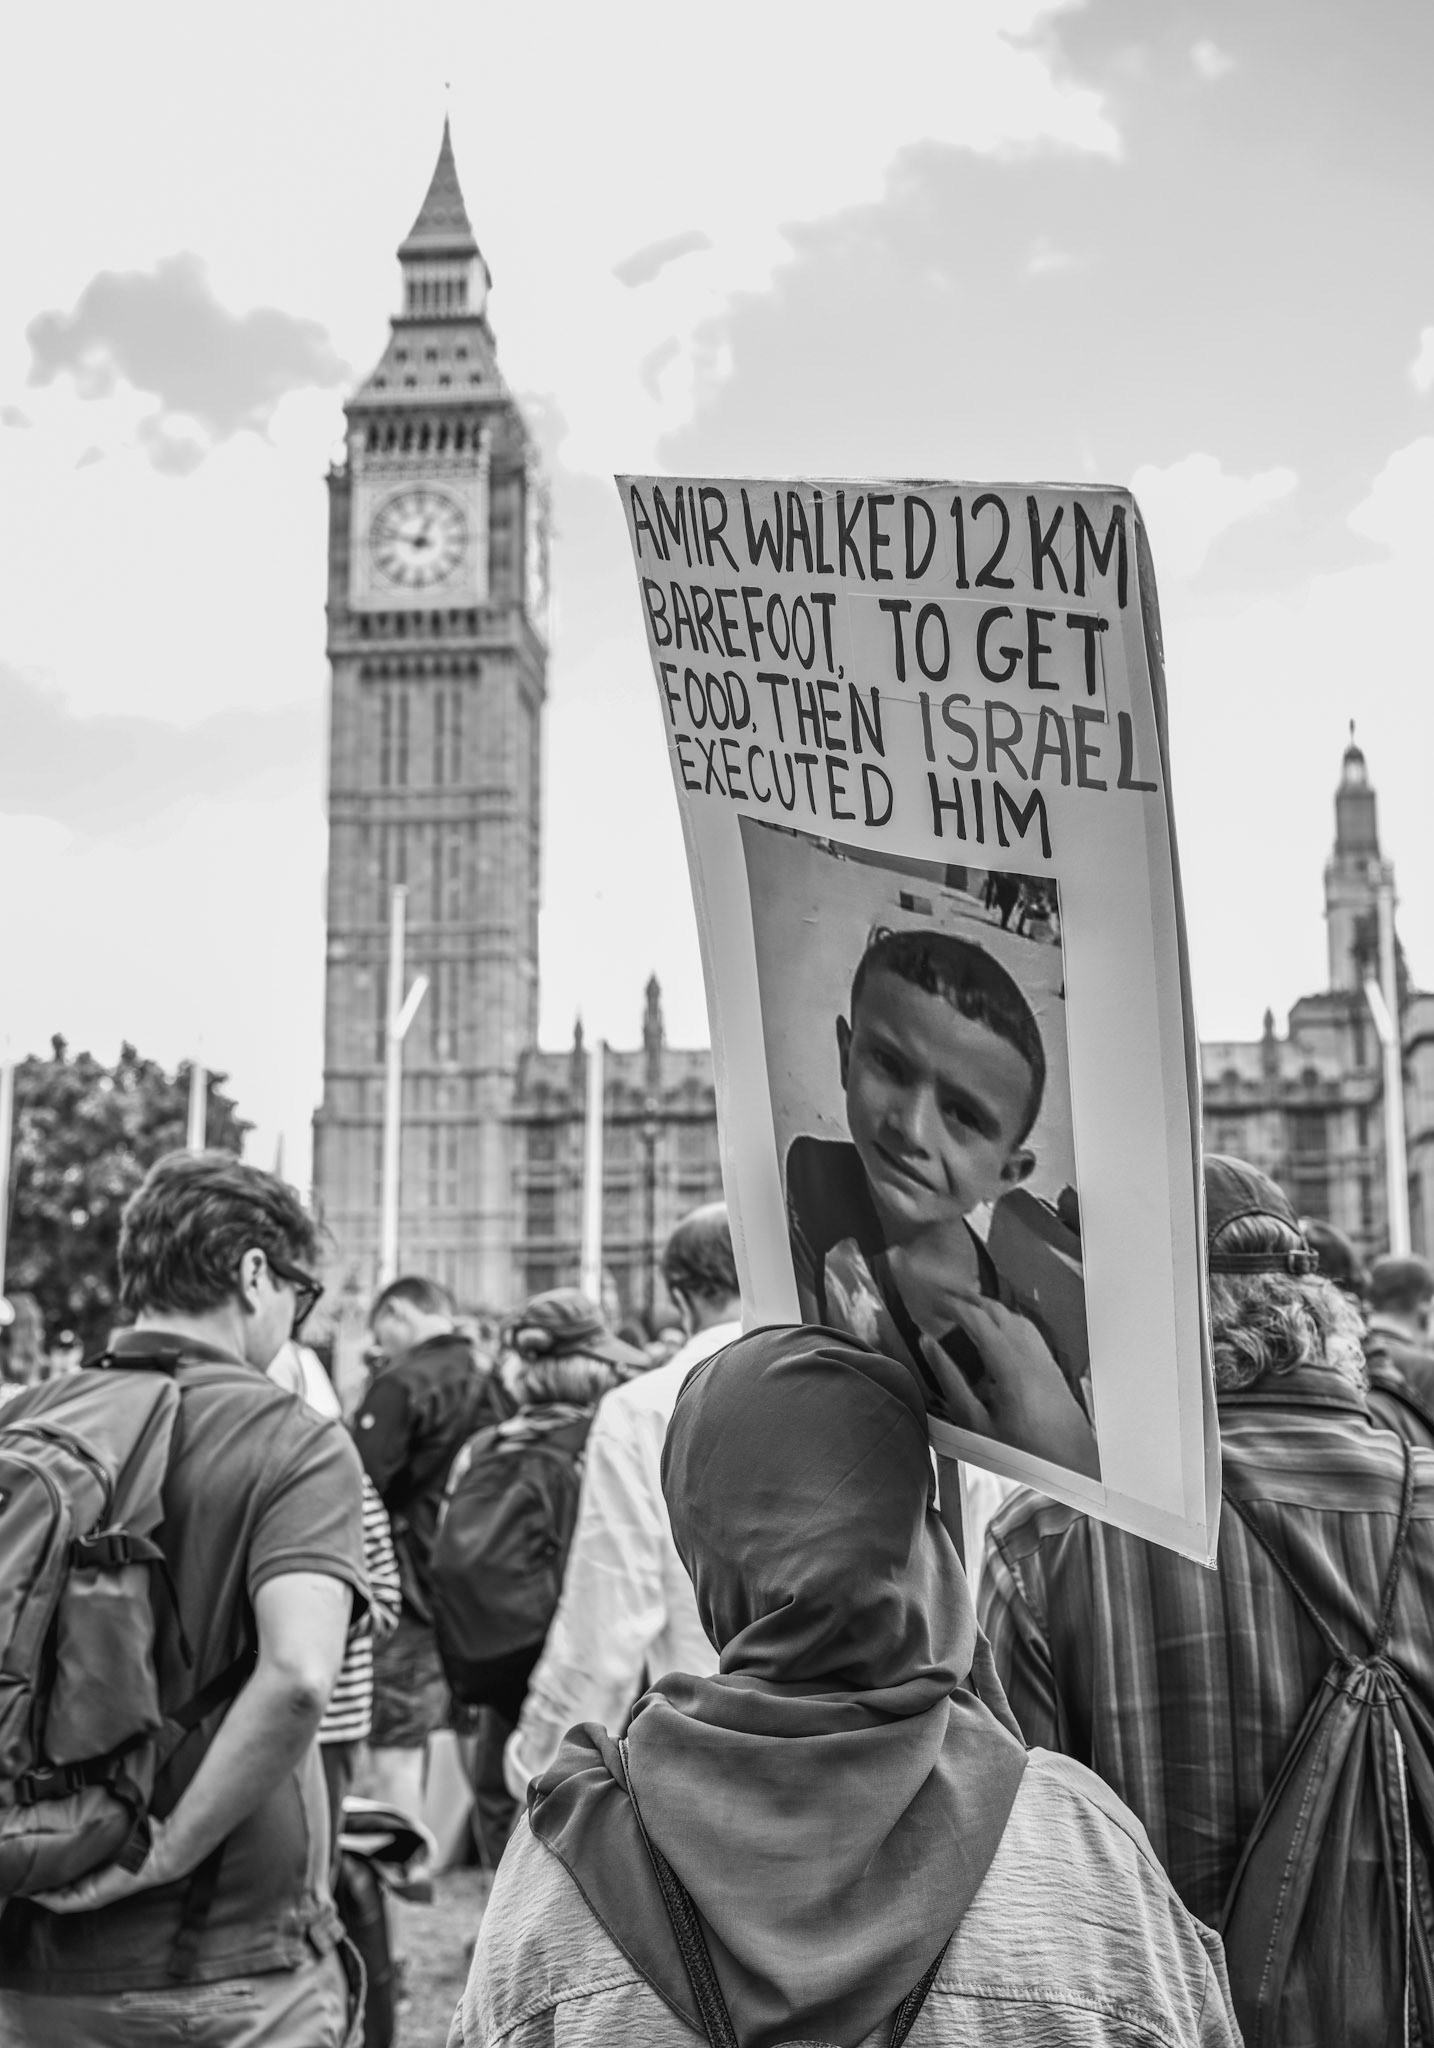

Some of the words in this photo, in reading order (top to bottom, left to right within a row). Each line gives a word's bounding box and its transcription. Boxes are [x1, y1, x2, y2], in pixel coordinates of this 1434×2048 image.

[629, 485, 740, 572] AMIR
[741, 488, 937, 581] WALKED
[952, 493, 1015, 590] 12
[1027, 495, 1128, 609] KM
[642, 577, 845, 680] BAREFOOT,
[879, 598, 951, 683] TO
[976, 606, 1109, 696] GET
[659, 661, 757, 733] FOOD,
[756, 672, 885, 758] THEN
[919, 691, 1158, 793] ISRAEL
[675, 734, 894, 827] EXECUTED
[927, 772, 1052, 859] HIM
